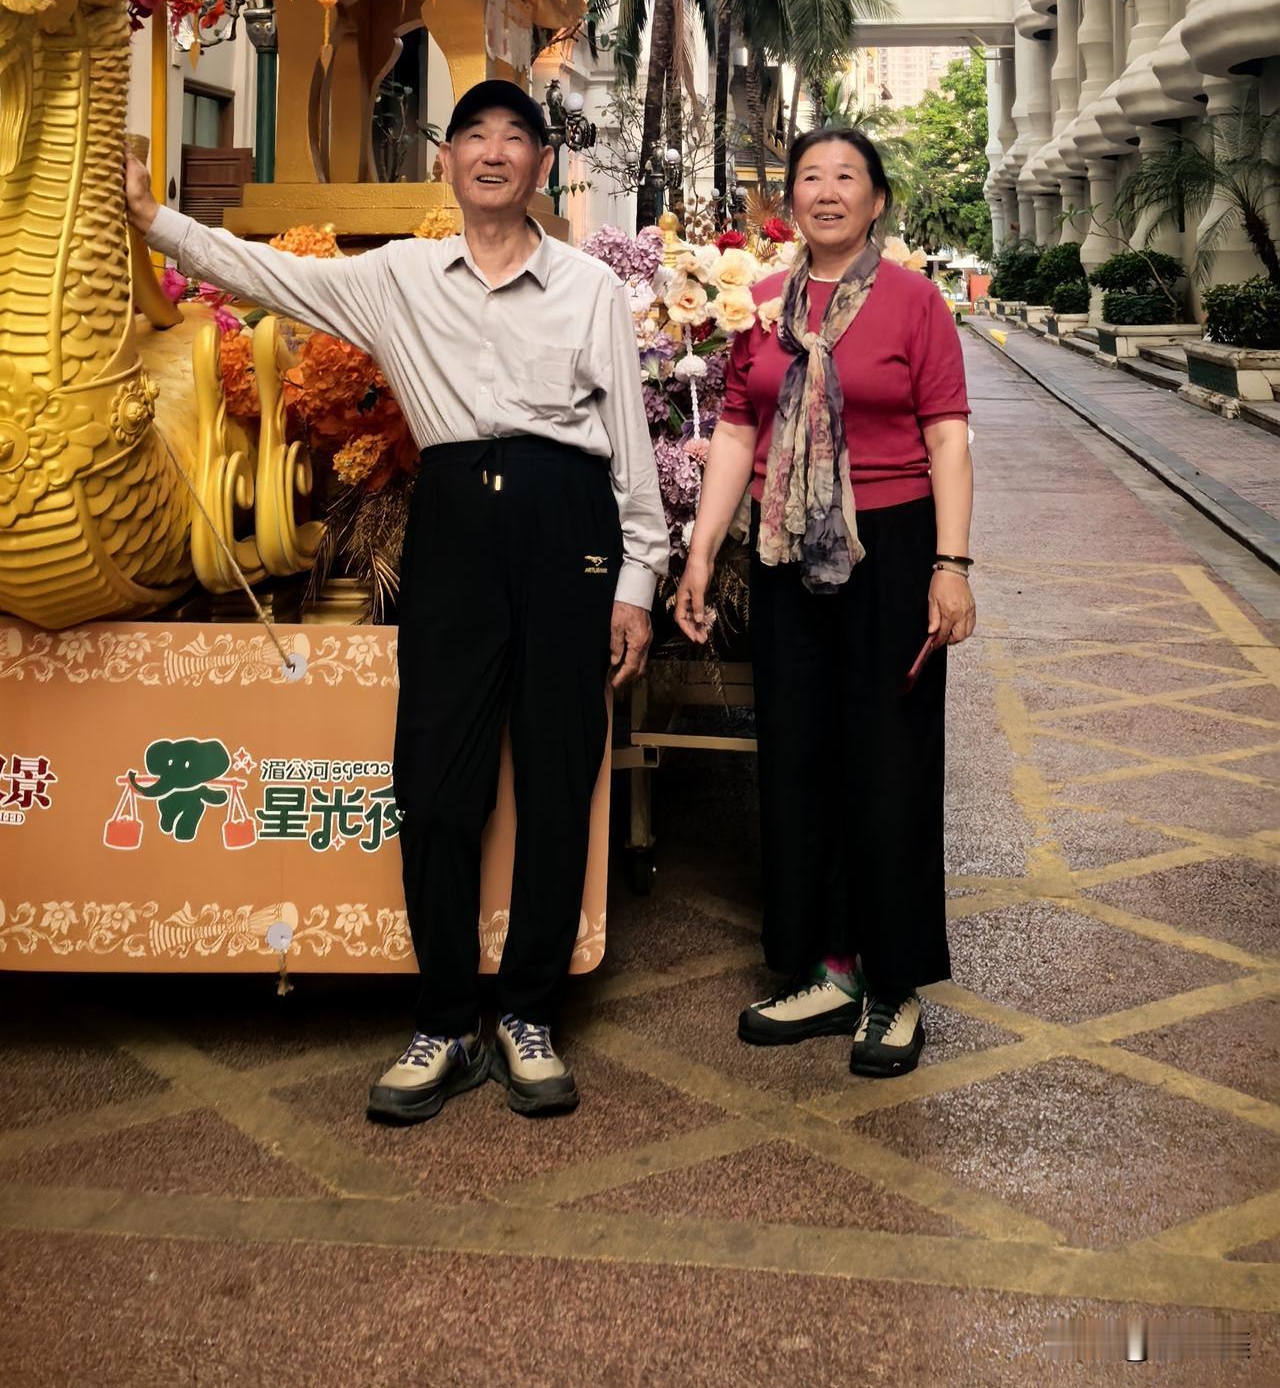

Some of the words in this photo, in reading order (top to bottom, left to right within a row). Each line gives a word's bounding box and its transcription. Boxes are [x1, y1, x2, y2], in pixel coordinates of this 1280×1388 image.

[0, 755, 57, 808] 景
[262, 760, 329, 781] 湄公河
